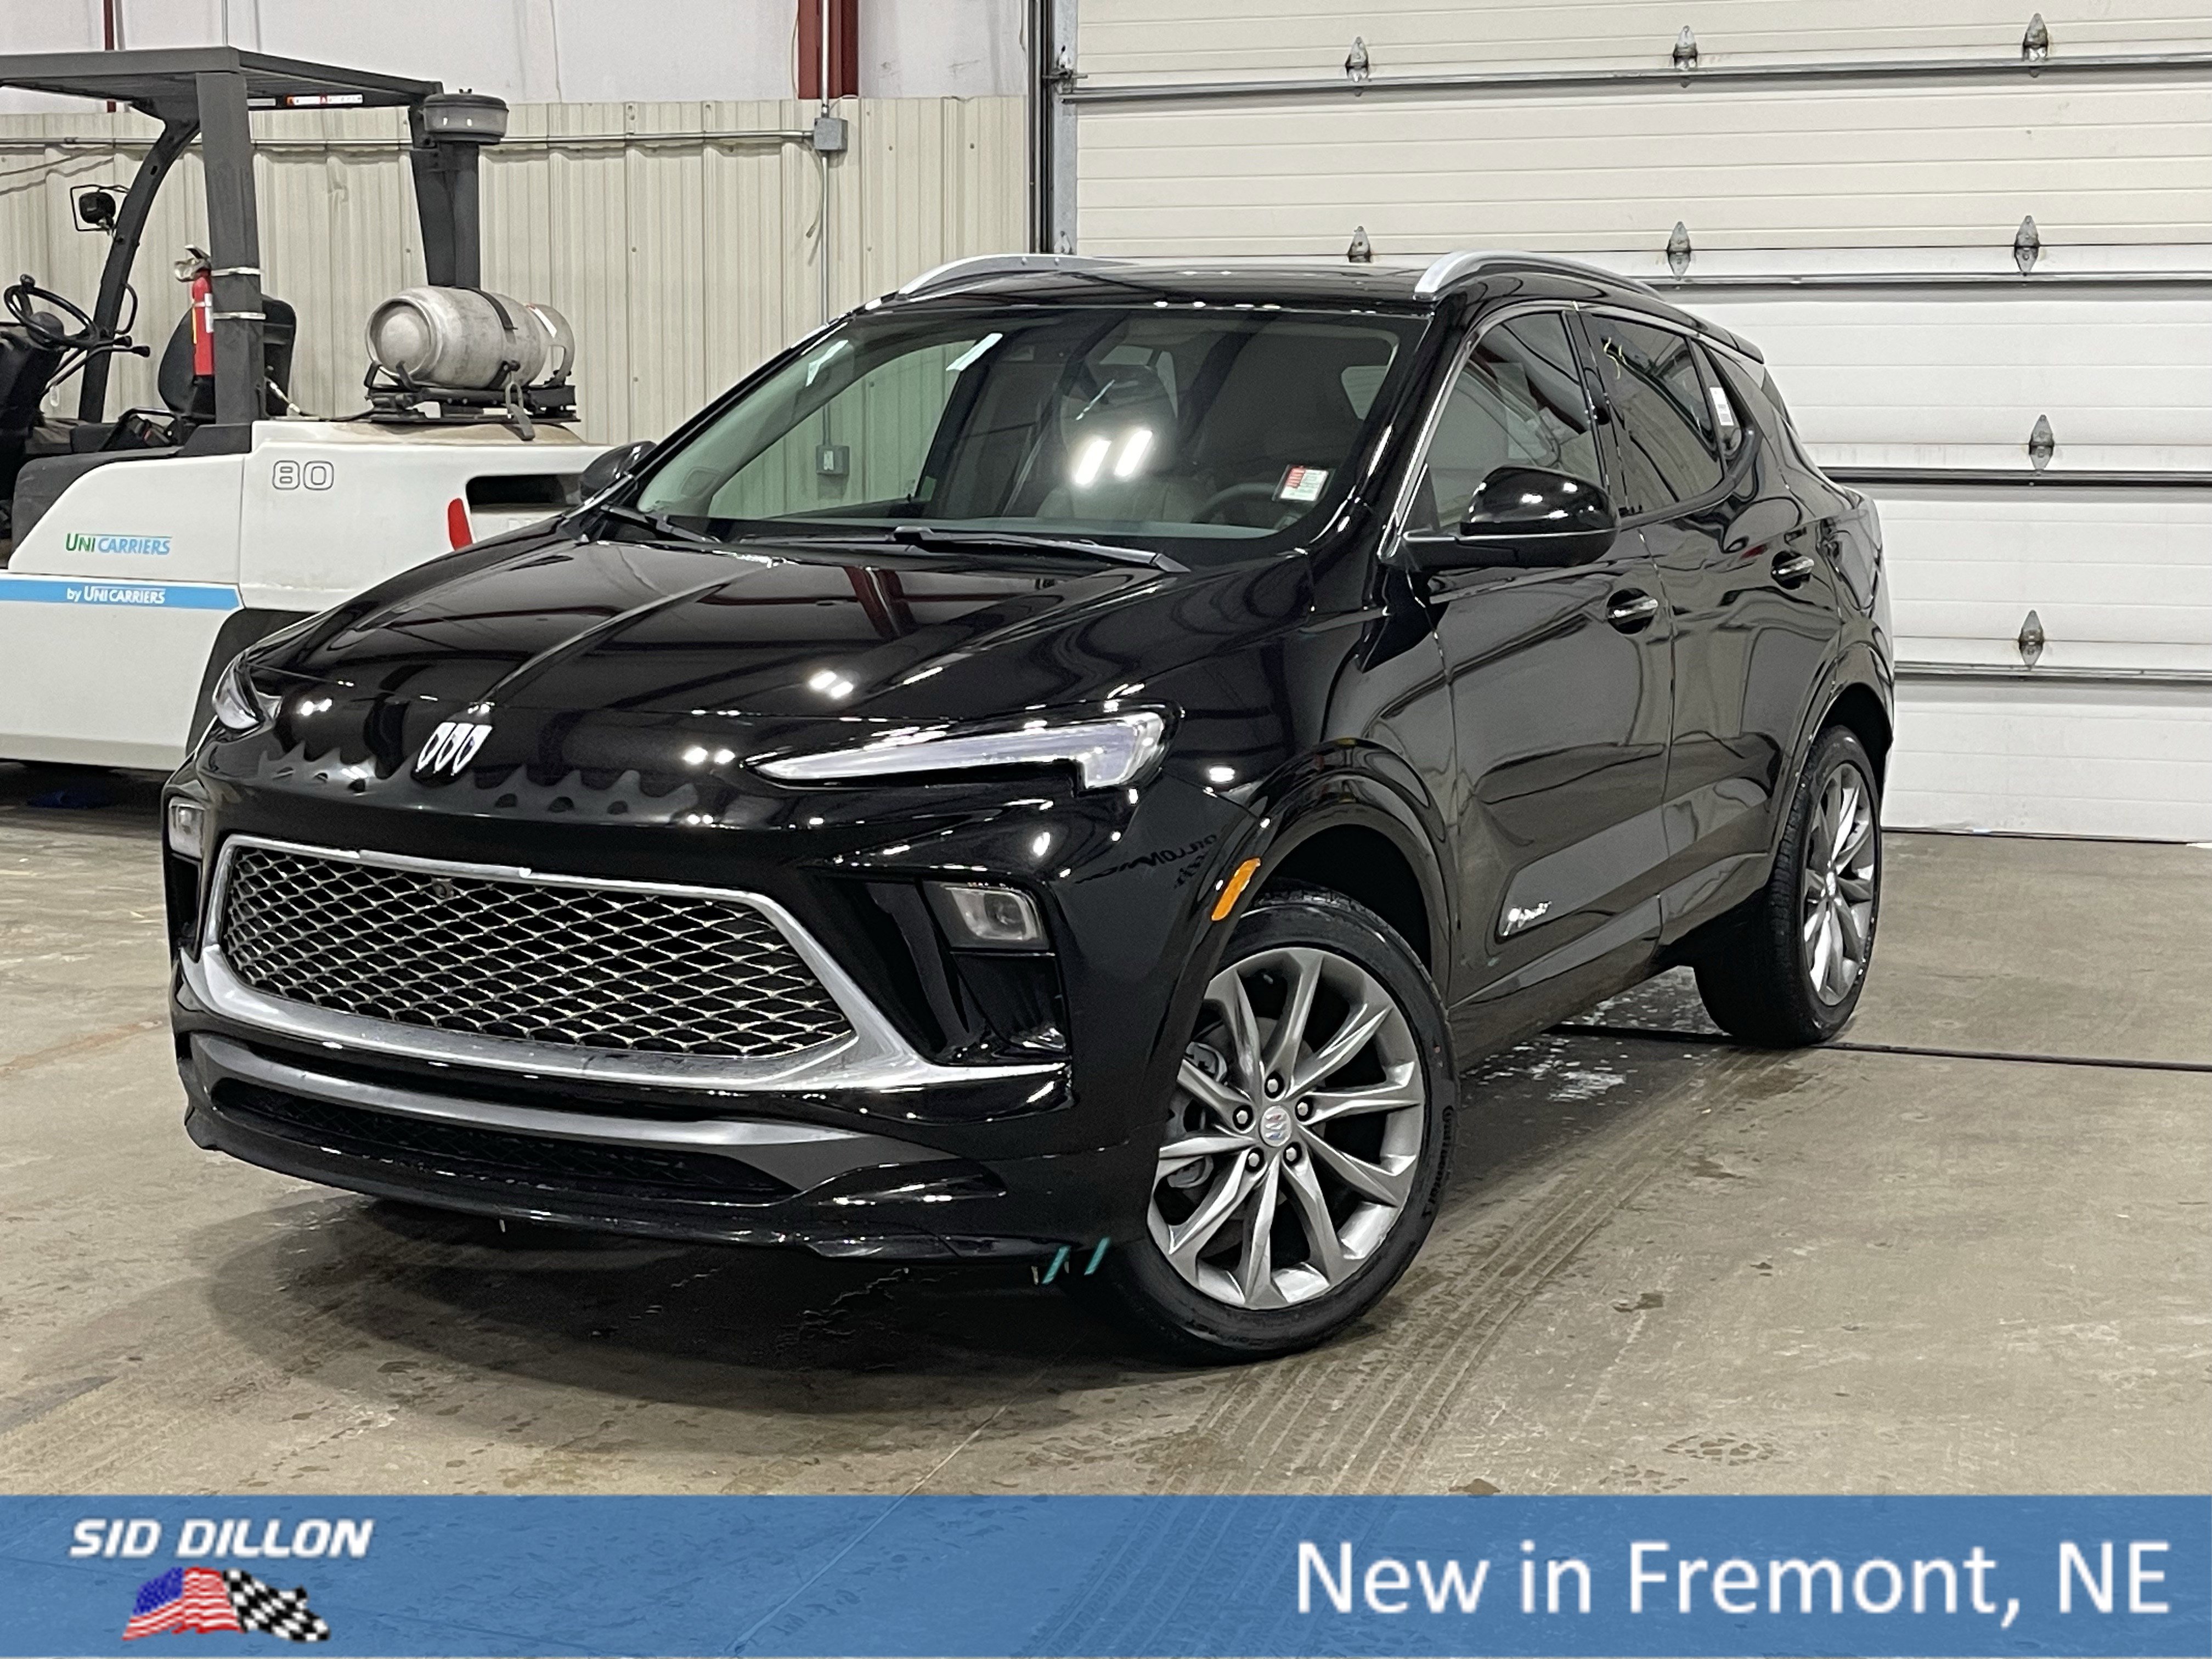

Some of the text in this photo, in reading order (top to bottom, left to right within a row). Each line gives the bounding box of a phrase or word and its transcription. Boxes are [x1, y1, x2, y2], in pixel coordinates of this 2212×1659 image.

[272, 460, 334, 490] 80
[66, 533, 172, 555] UNICARRIERS
[67, 585, 166, 603] by UNICARRIERS
